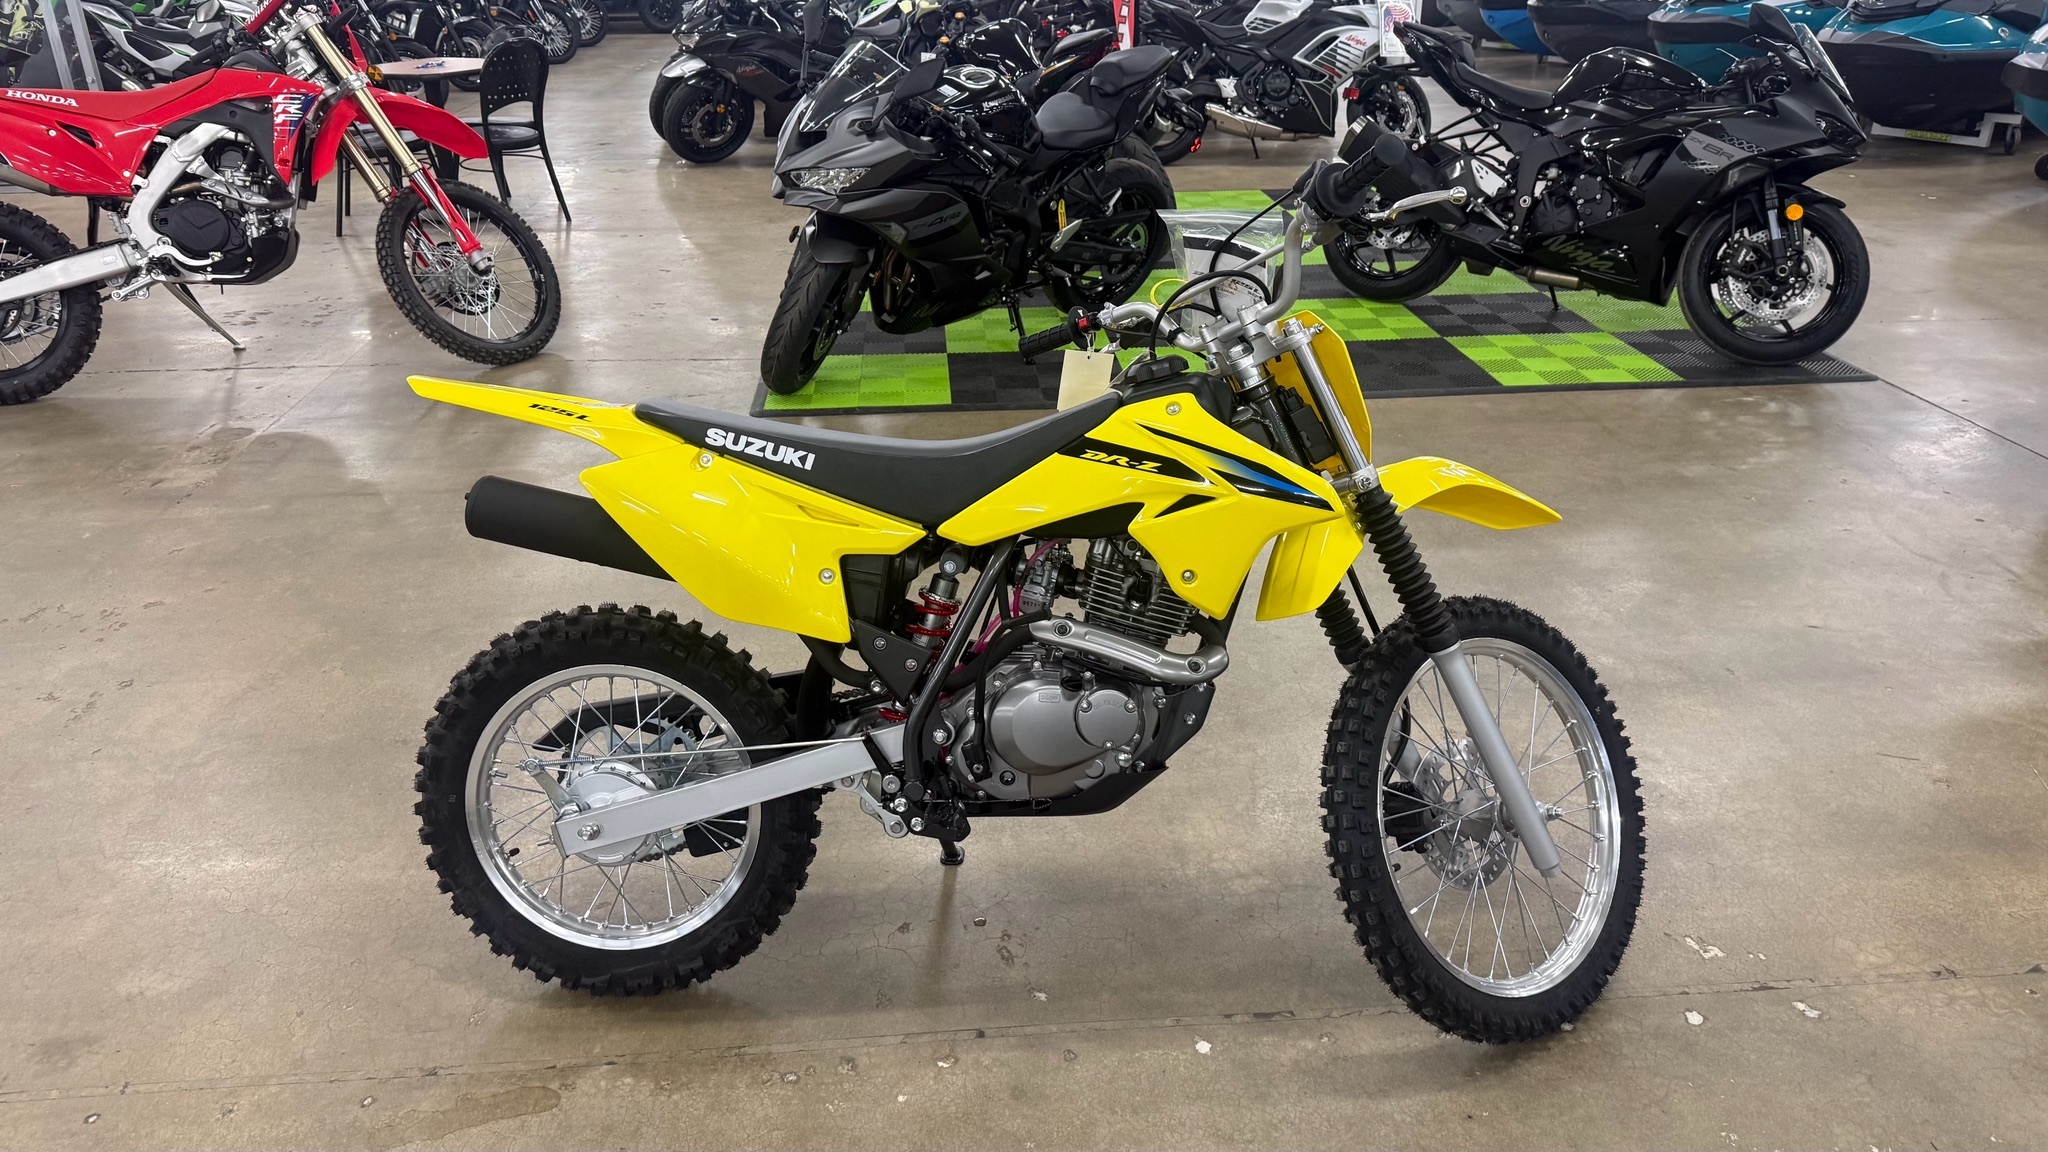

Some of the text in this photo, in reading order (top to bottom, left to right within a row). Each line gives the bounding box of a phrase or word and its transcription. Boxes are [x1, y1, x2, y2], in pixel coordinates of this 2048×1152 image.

[6, 89, 79, 107] HONDA
[1542, 234, 1616, 273] Ninja
[528, 403, 592, 422] 125L
[704, 427, 816, 471] SUZUKI
[1079, 448, 1163, 472] DR-Z
